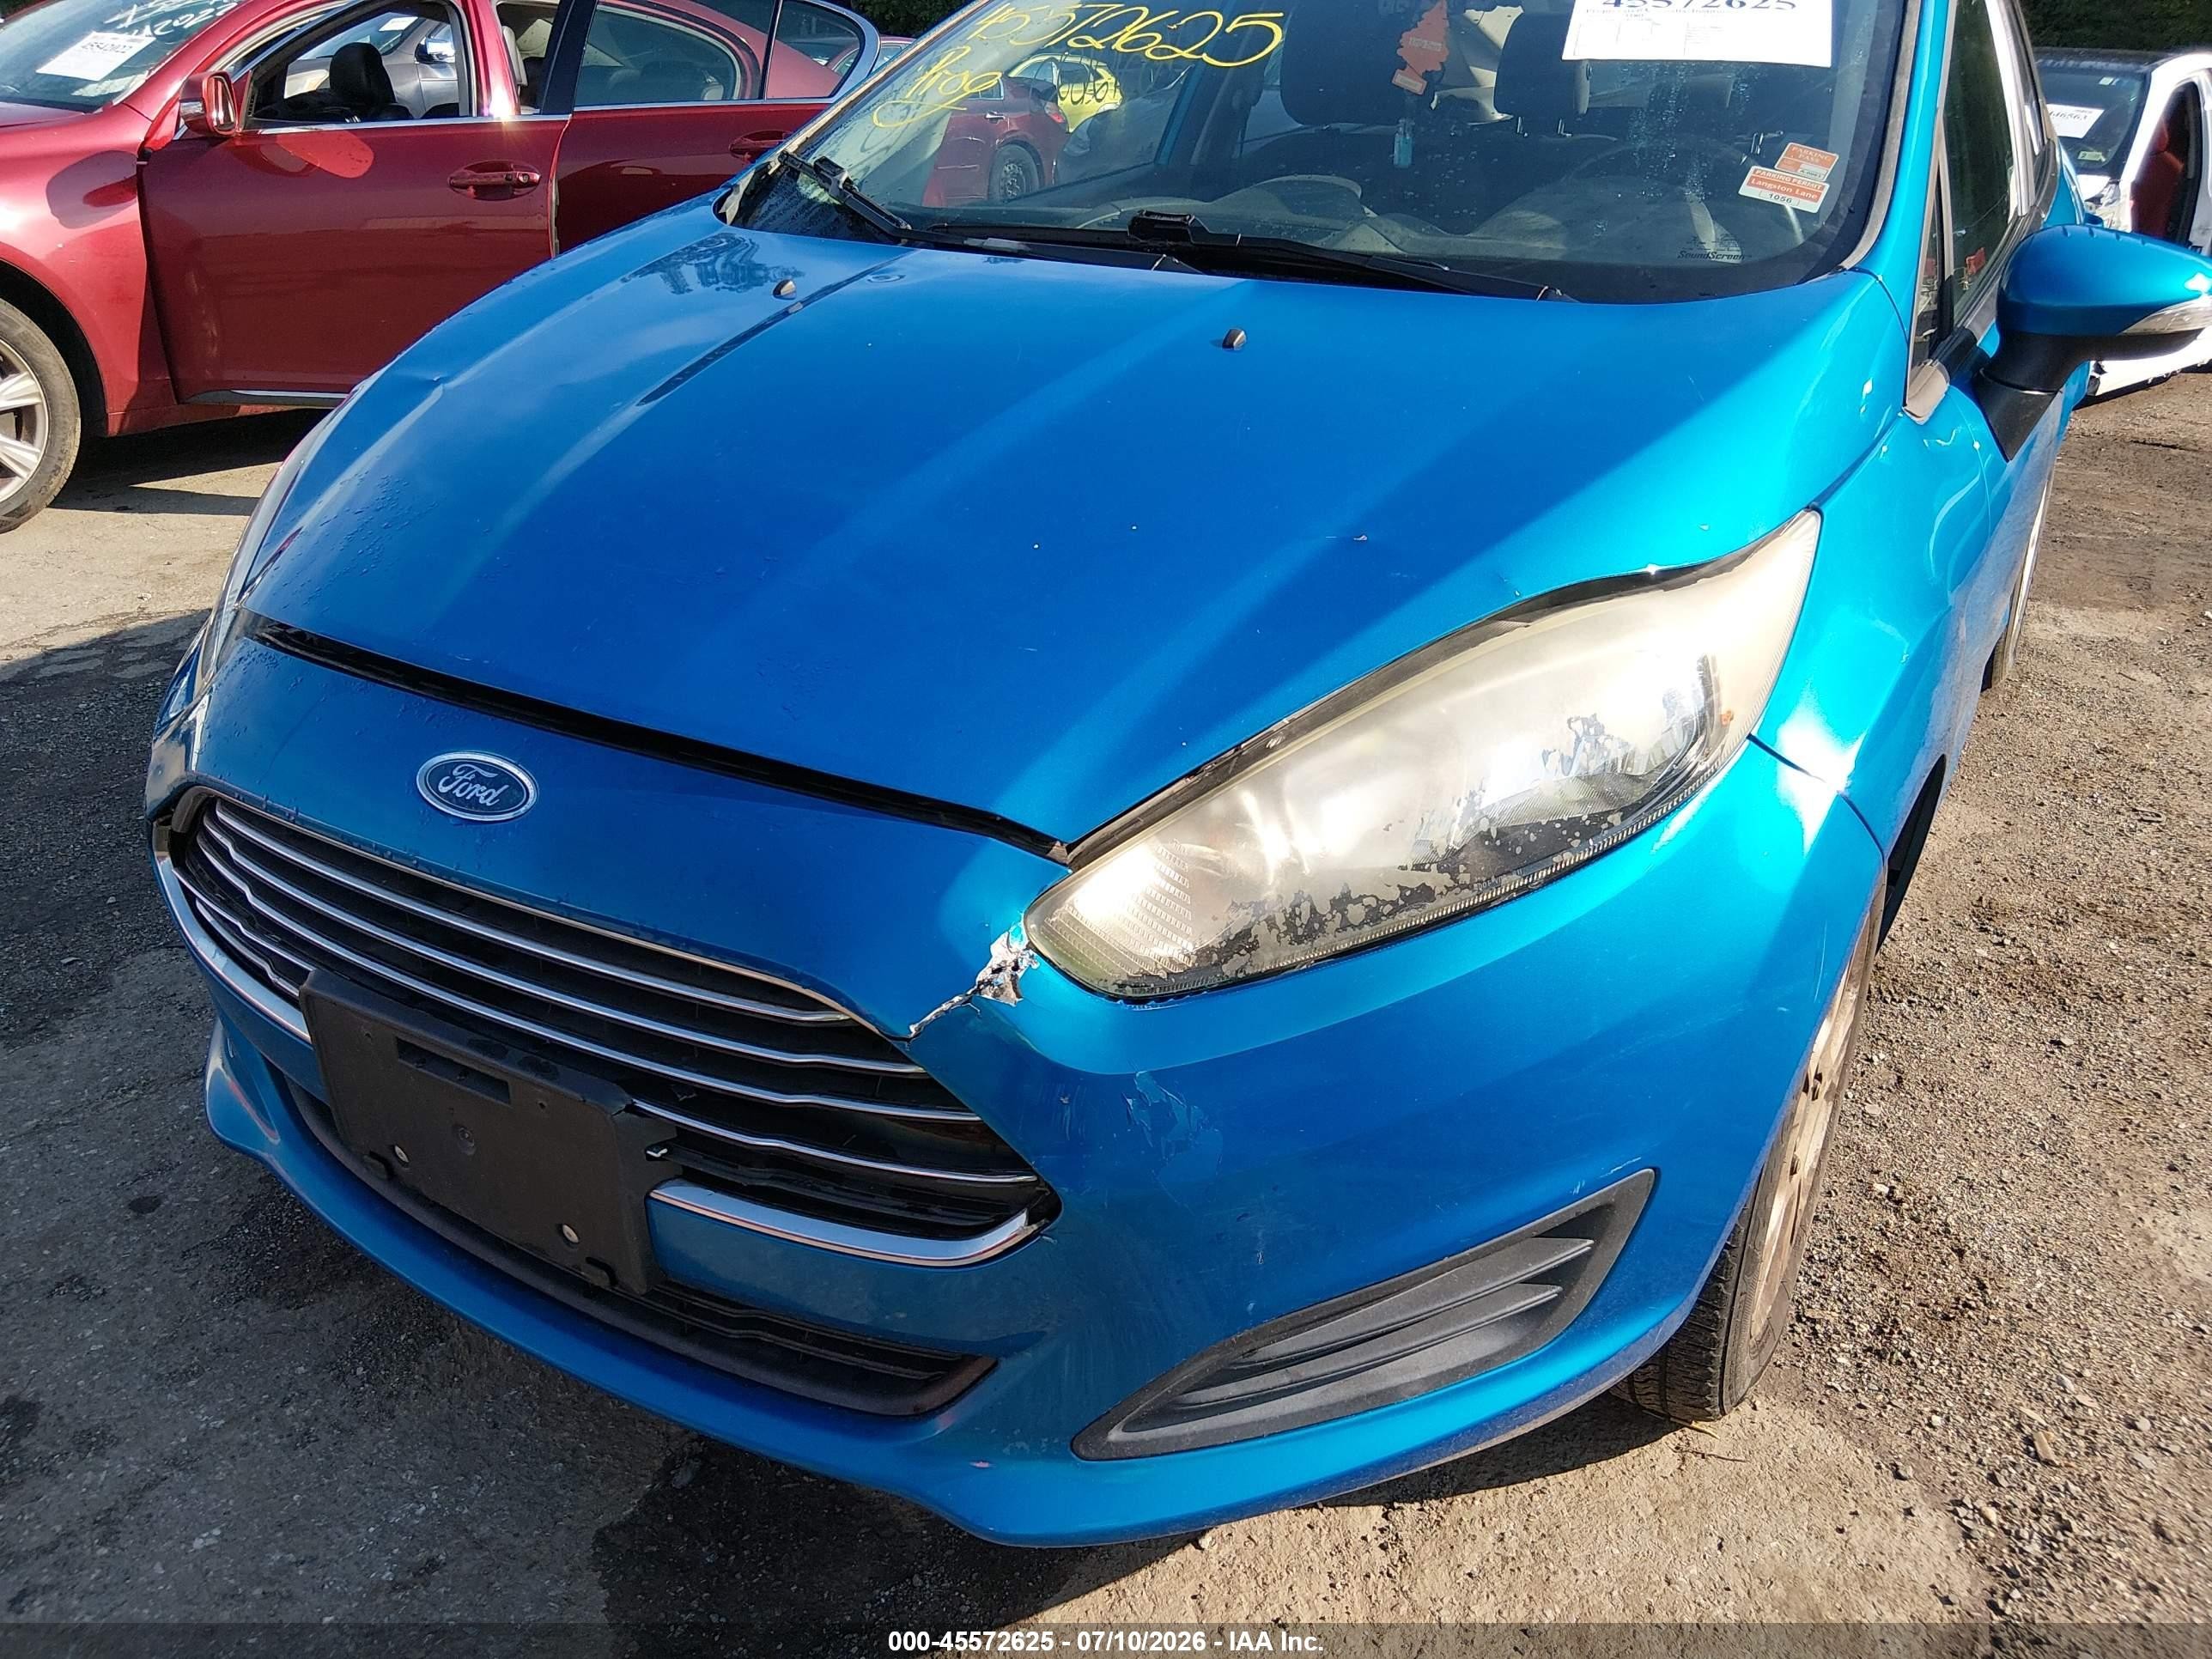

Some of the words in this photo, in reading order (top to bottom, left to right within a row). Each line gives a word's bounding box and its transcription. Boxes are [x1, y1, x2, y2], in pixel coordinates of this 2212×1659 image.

[967, 3, 1285, 67] 45572625
[1751, 178, 1792, 194] Langston
[1795, 189, 1818, 199] Lane
[1754, 169, 1790, 182] PARKING
[1791, 177, 1822, 190] PERMIT
[1768, 192, 1792, 204] 1056
[1677, 250, 1745, 260] SoundScreen
[438, 763, 508, 806] Ford
